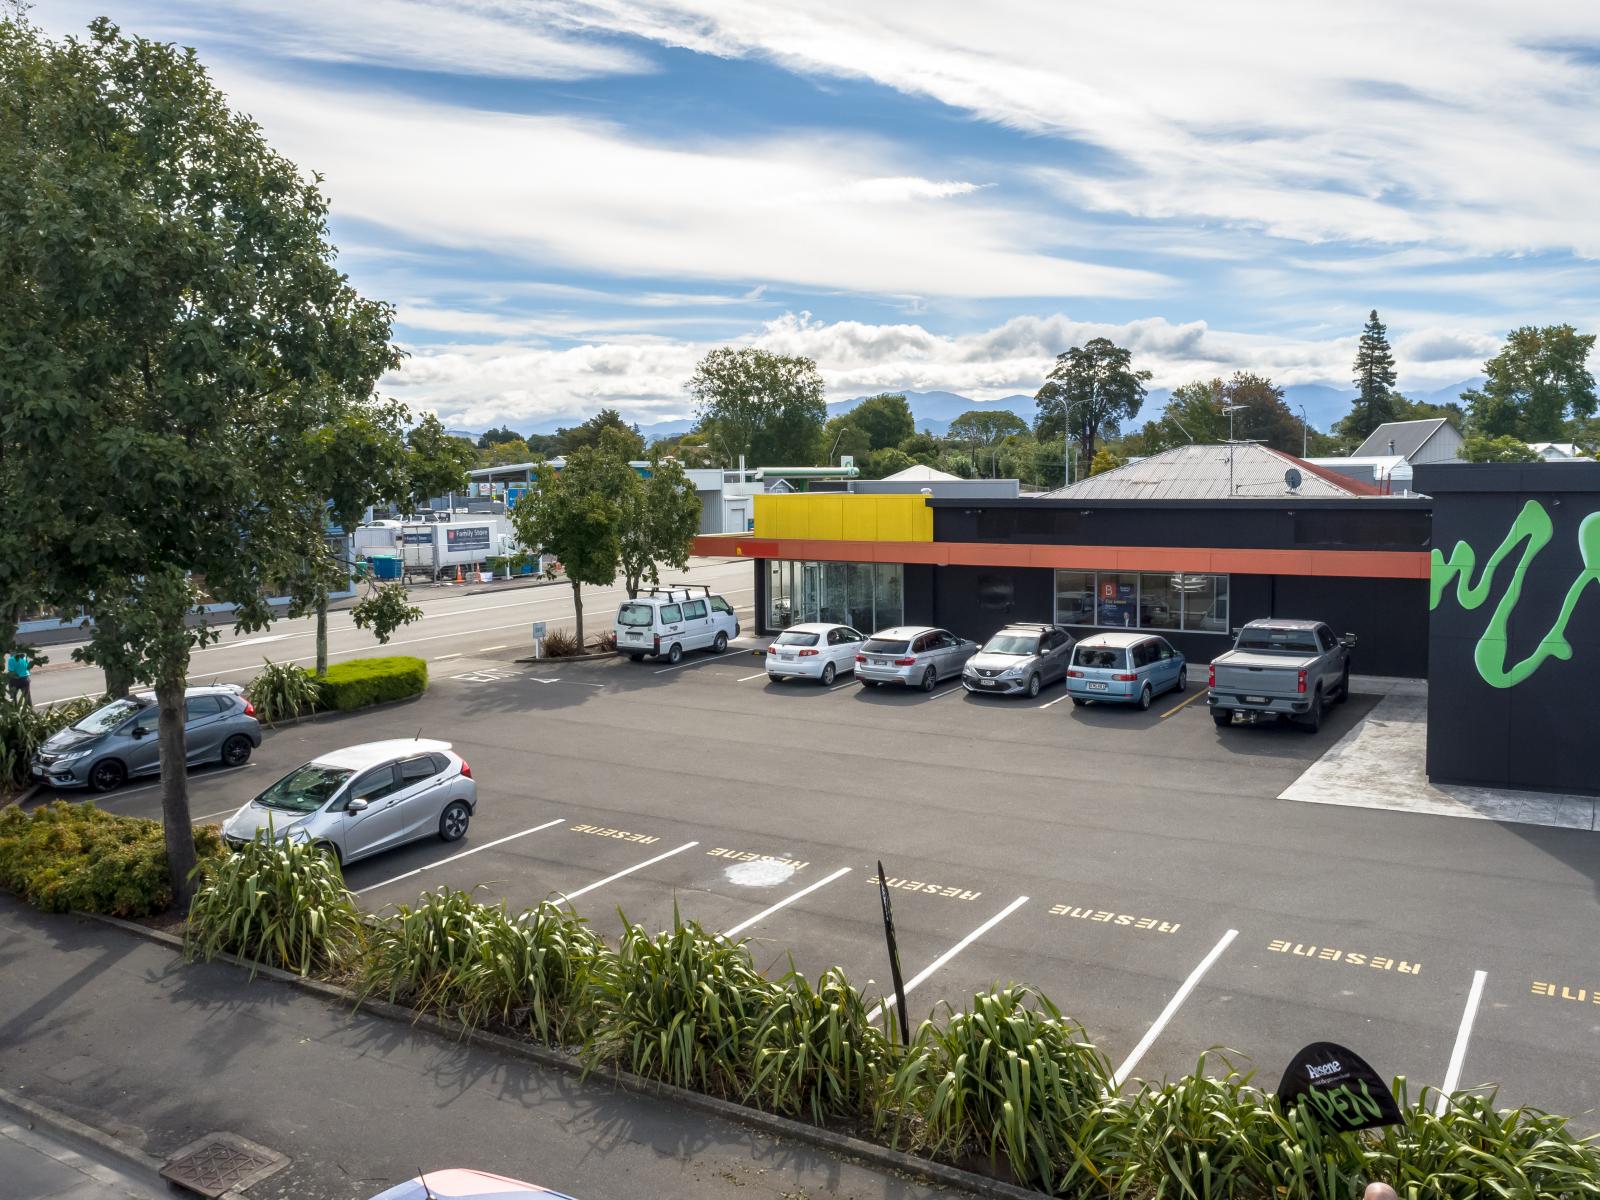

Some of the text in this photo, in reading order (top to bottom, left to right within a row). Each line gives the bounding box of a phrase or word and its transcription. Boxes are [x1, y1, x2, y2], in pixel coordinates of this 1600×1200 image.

[456, 528, 488, 538] Family Store
[1105, 584, 1113, 596] B
[570, 824, 661, 845] RESENE
[866, 875, 983, 901] RESENE
[1048, 904, 1182, 934] RESENE
[1266, 939, 1422, 975] RESENE
[1305, 1060, 1342, 1079] Resene
